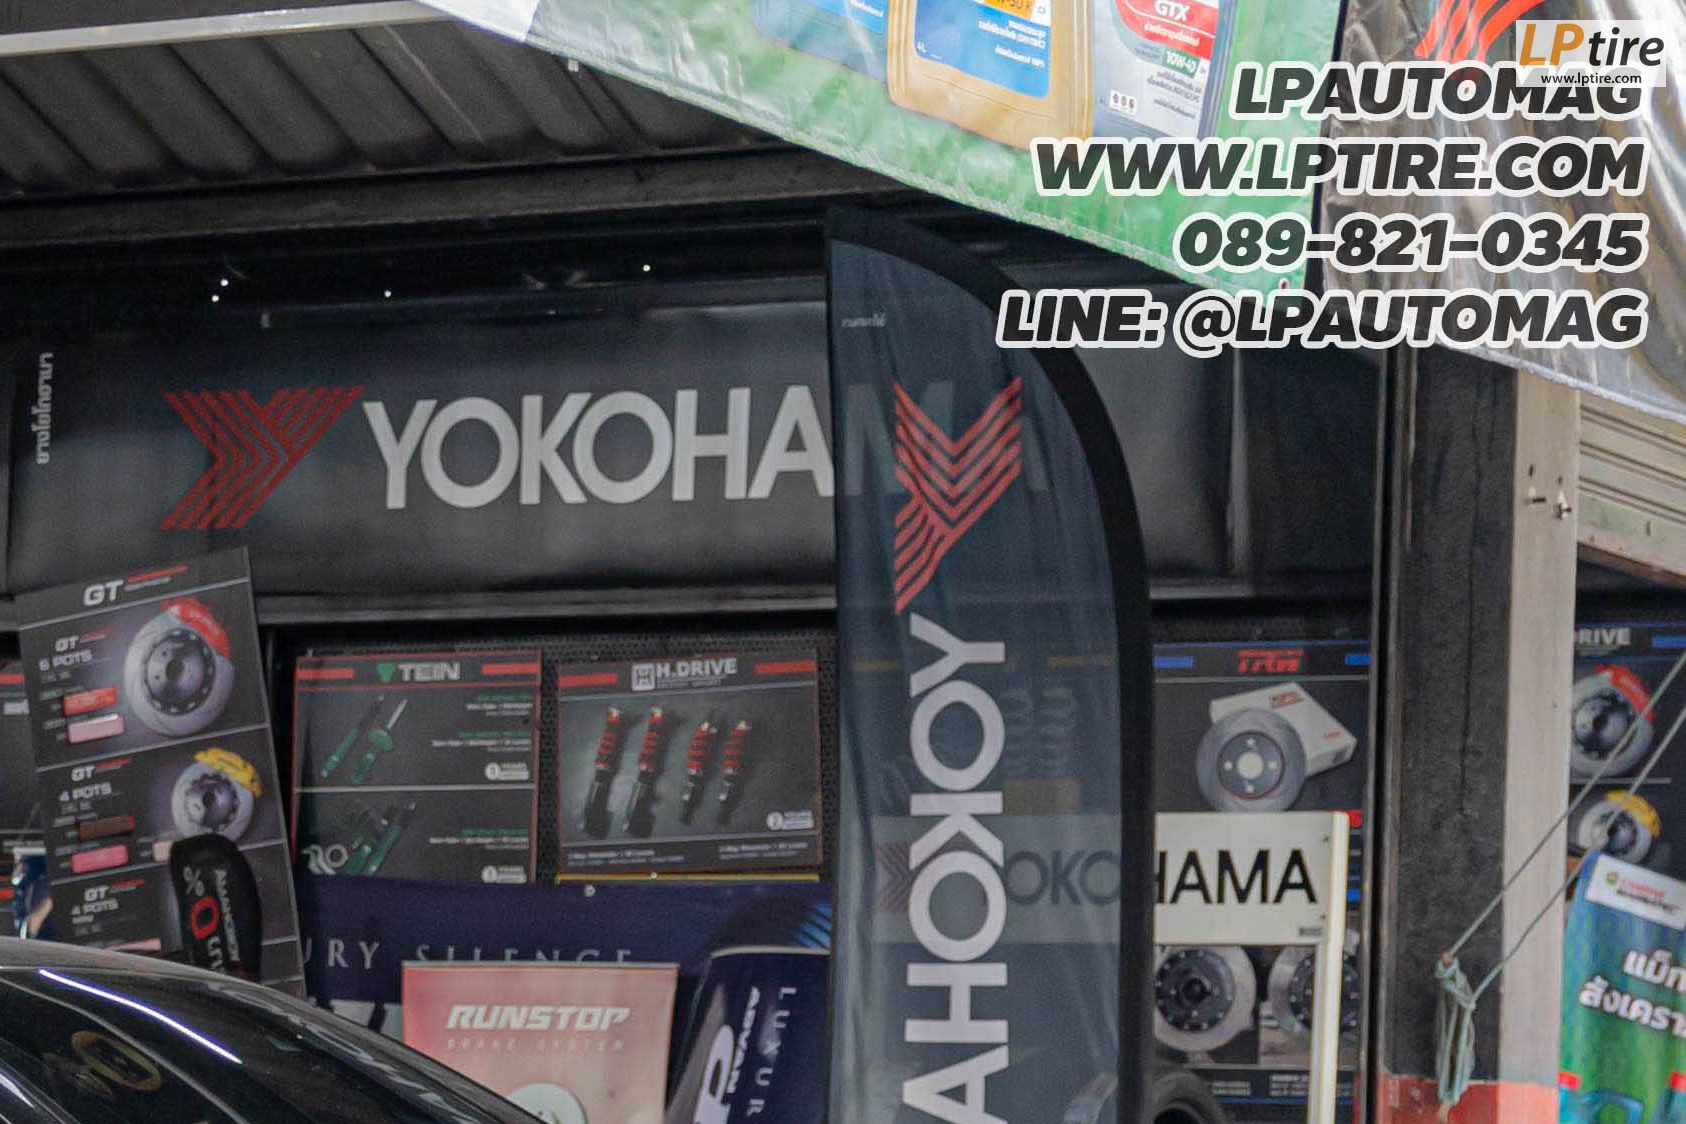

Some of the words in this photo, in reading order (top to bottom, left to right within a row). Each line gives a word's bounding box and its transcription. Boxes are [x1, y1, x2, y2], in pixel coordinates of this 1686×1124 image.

[83, 579, 125, 606] GT
[52, 650, 93, 668] POTS
[656, 657, 738, 678] H.DRIVE
[398, 661, 461, 681] TEIN
[72, 782, 112, 800] POTS
[446, 1004, 631, 1031] RUNSTOP
